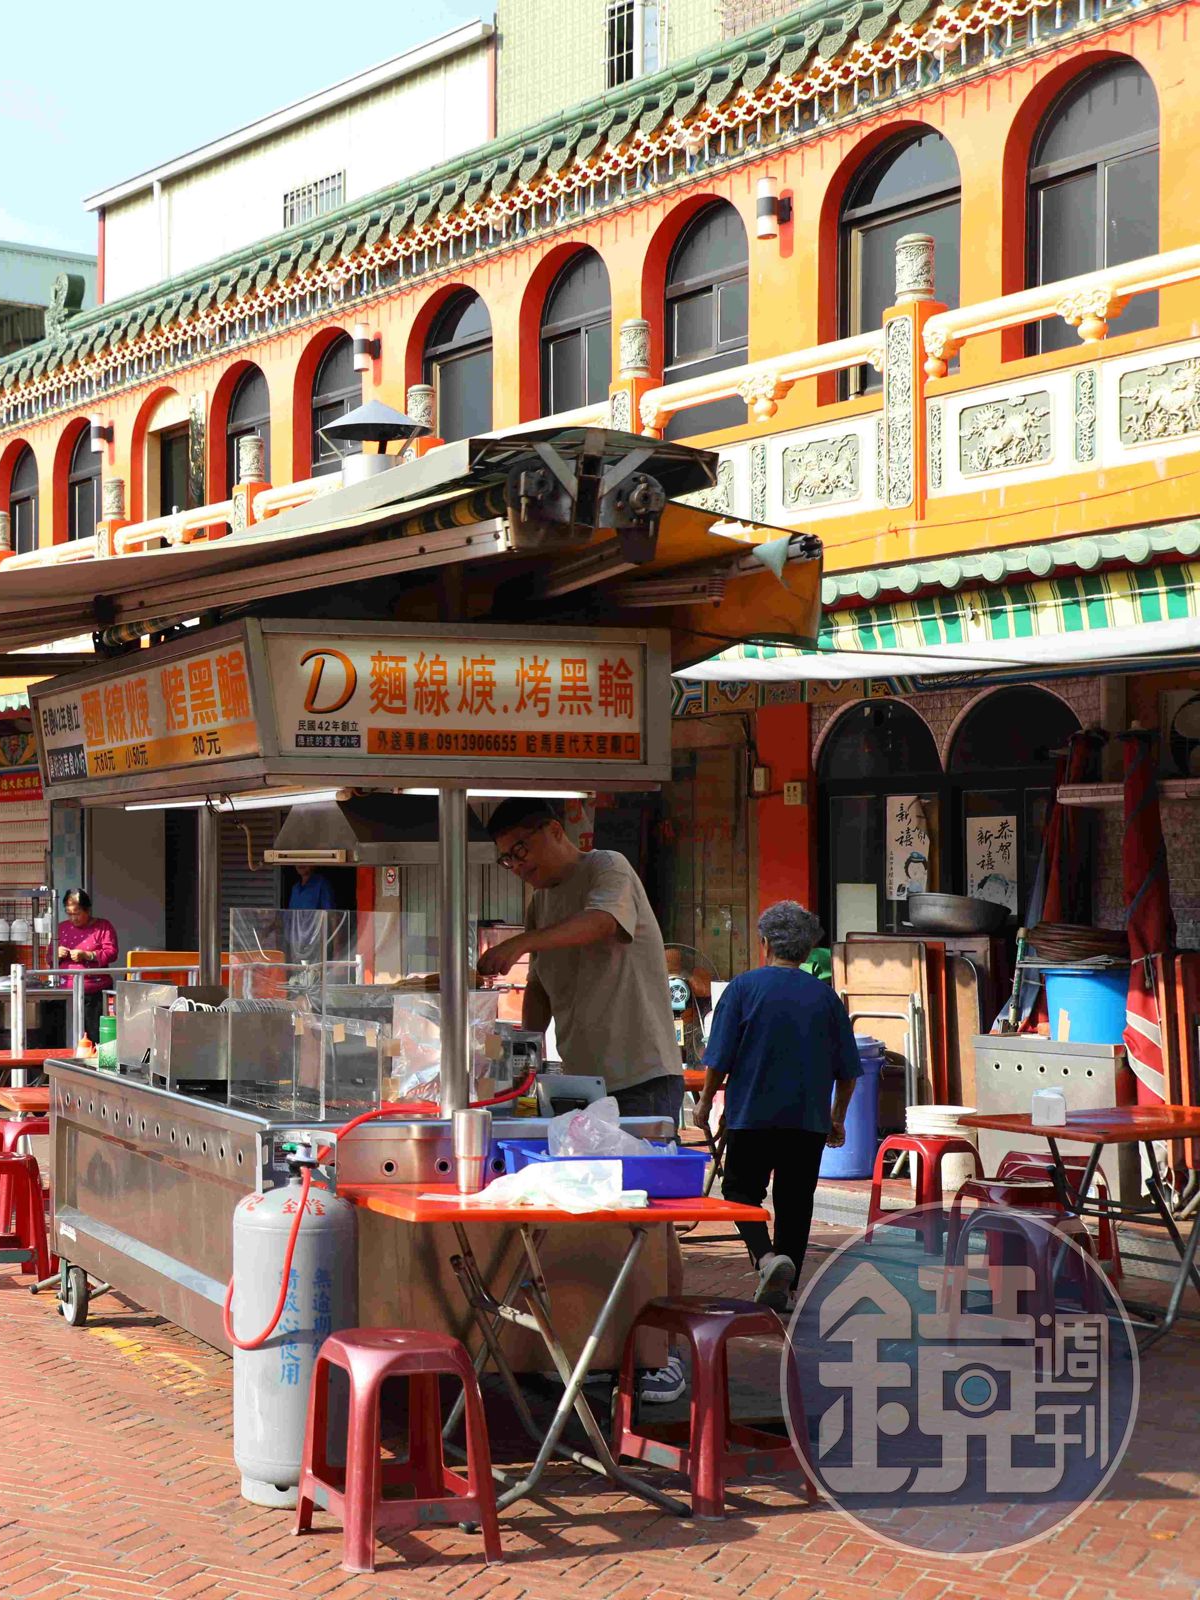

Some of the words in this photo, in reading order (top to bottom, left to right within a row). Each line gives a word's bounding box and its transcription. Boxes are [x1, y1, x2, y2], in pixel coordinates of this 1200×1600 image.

[160, 650, 249, 731] 烤黑輪
[300, 648, 357, 714] D
[192, 731, 221, 755] 30元
[298, 719, 359, 732] 民國42年創立
